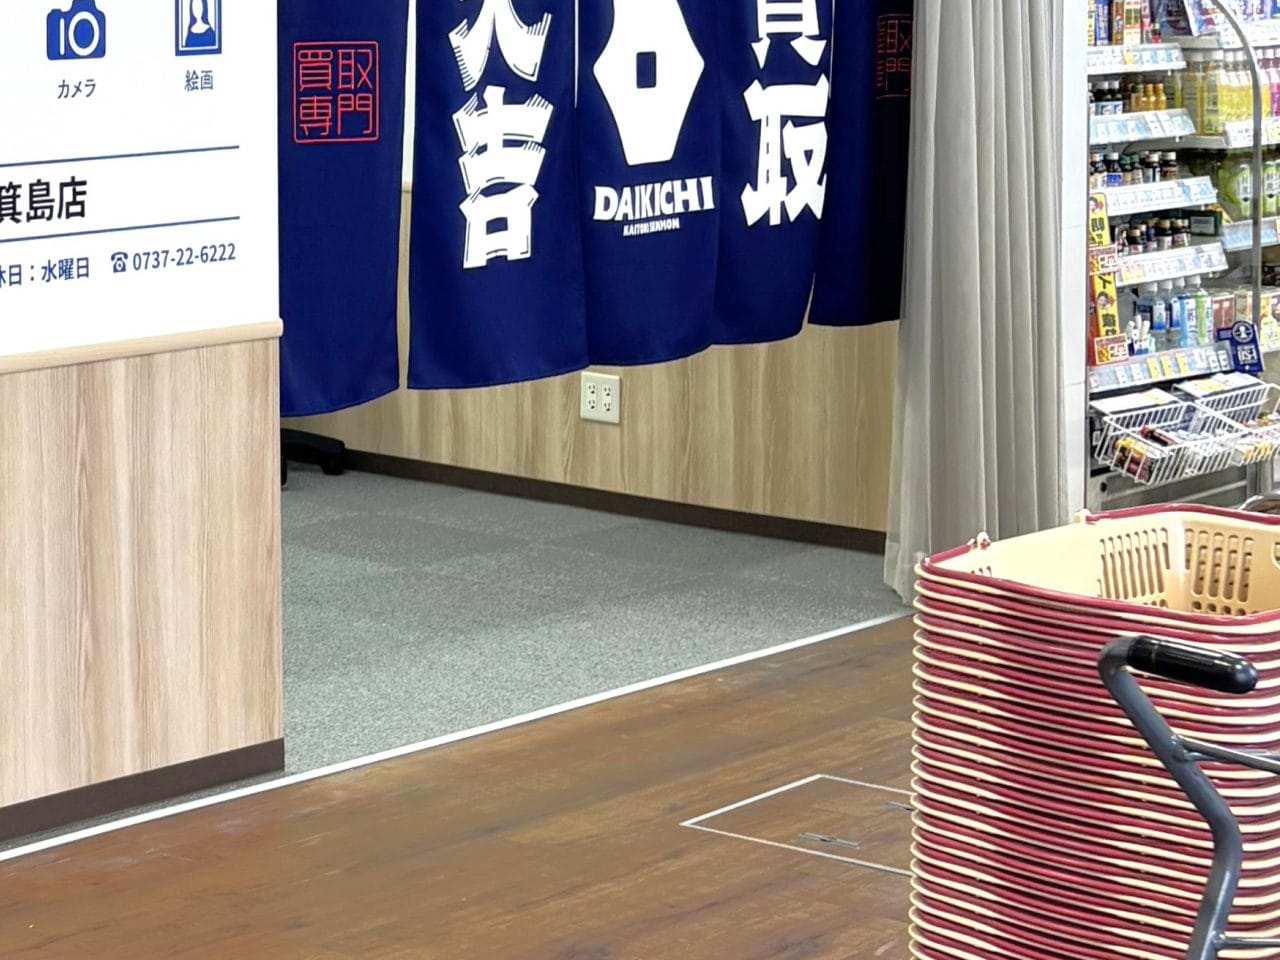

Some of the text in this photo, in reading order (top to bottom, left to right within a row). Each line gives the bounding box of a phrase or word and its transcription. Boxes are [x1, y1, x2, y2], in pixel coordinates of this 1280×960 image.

[184, 69, 214, 91] 絵画
[298, 49, 372, 92] 買取
[58, 78, 97, 99] カメラ
[299, 95, 372, 136] 専門
[593, 176, 715, 221] DAIKICHI
[132, 243, 236, 271] 0737-22-6222
